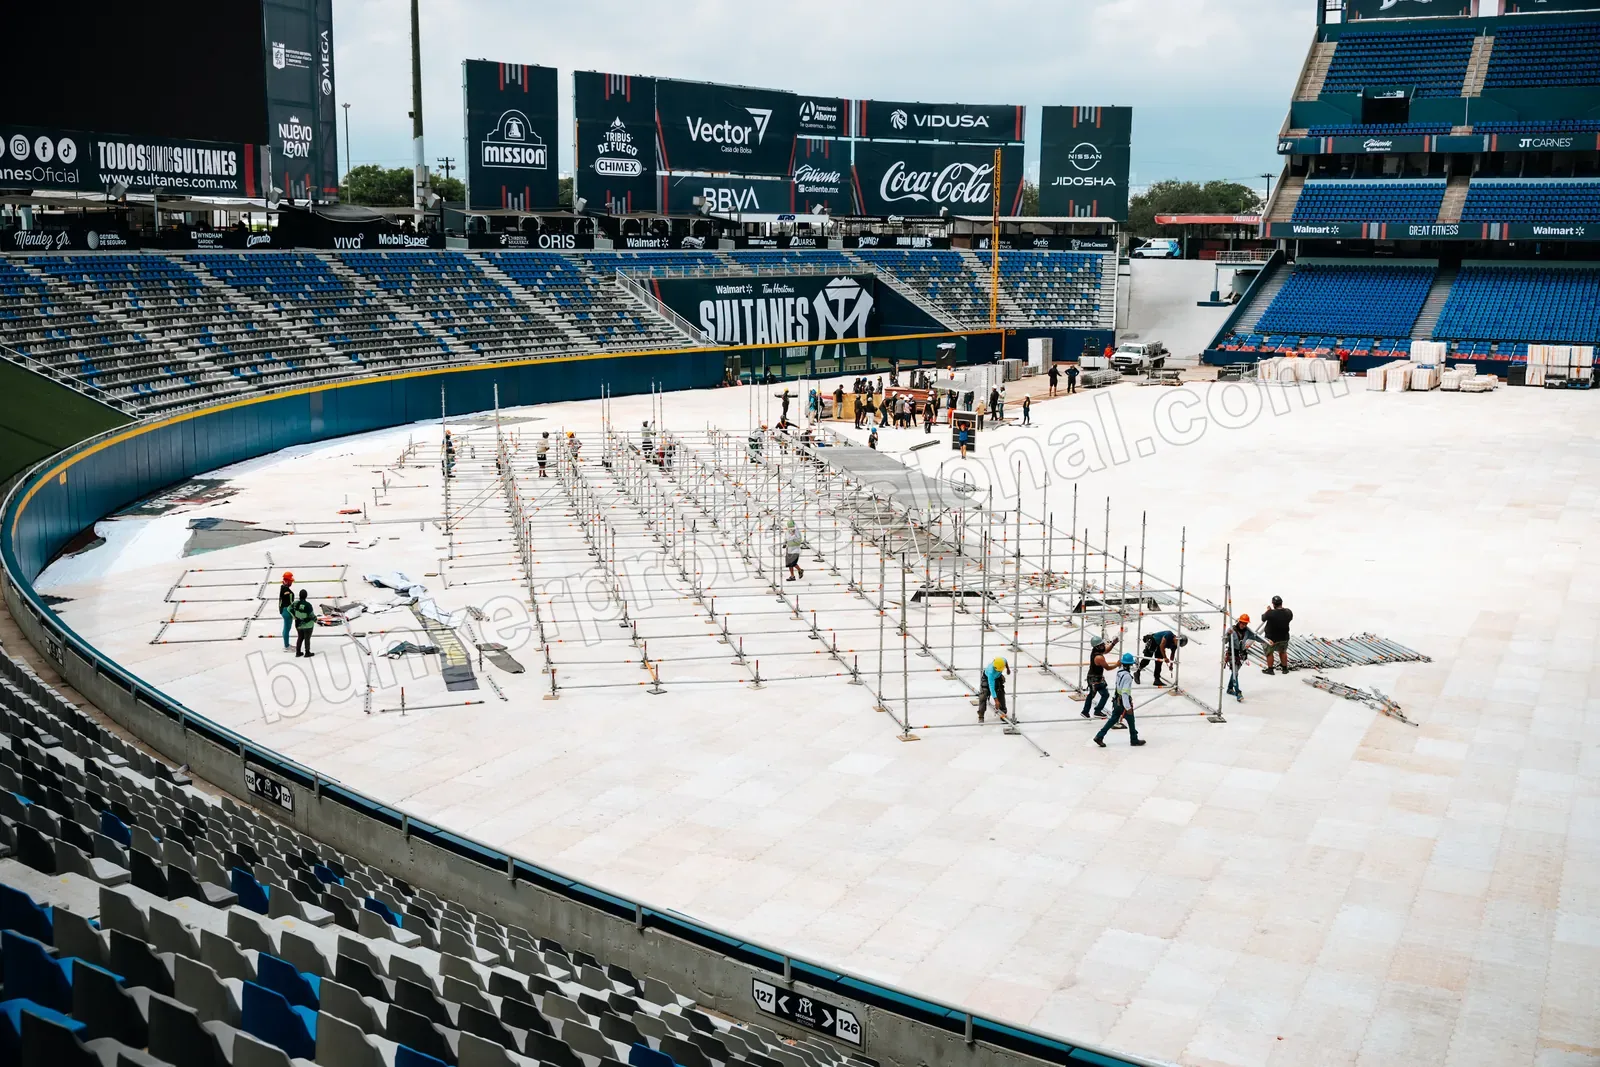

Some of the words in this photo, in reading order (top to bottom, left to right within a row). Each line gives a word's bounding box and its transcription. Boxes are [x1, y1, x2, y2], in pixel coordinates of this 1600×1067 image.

[320, 30, 330, 78] MEGA
[814, 112, 836, 122] Ahorro
[913, 114, 990, 128] VIDUSA
[605, 132, 632, 142] TRIBUS
[686, 116, 752, 145] Vector
[484, 146, 545, 165] MISSION
[597, 142, 610, 154] DE
[610, 142, 638, 156] FUEGO
[720, 145, 732, 153] Casa
[740, 146, 752, 154] Bolsa
[598, 161, 638, 172] CHIMEX
[793, 164, 841, 184] Caliente
[1051, 176, 1116, 186] JIDOSHA
[99, 173, 238, 190] www.sultanes.com.mx
[880, 160, 996, 203] Coca-Cola
[804, 184, 839, 194] caliente.mx
[702, 186, 760, 212] BBVA
[1293, 226, 1330, 234] Walmart
[1408, 225, 1430, 236] GREAT
[1432, 224, 1459, 235] FITNESS
[1533, 226, 1574, 235] Walmart
[14, 230, 54, 250] Méndez
[56, 230, 72, 250] Jr.
[246, 234, 271, 248] Clamato
[538, 234, 576, 249] ORIS
[626, 238, 660, 248] Walmart
[896, 236, 911, 245] JOHN
[716, 284, 746, 294] Walmart
[762, 284, 772, 294] Tim
[773, 283, 795, 293] Hortons
[699, 296, 809, 346] SULTANES
[755, 989, 773, 1004] 127
[838, 1018, 858, 1034] 126
